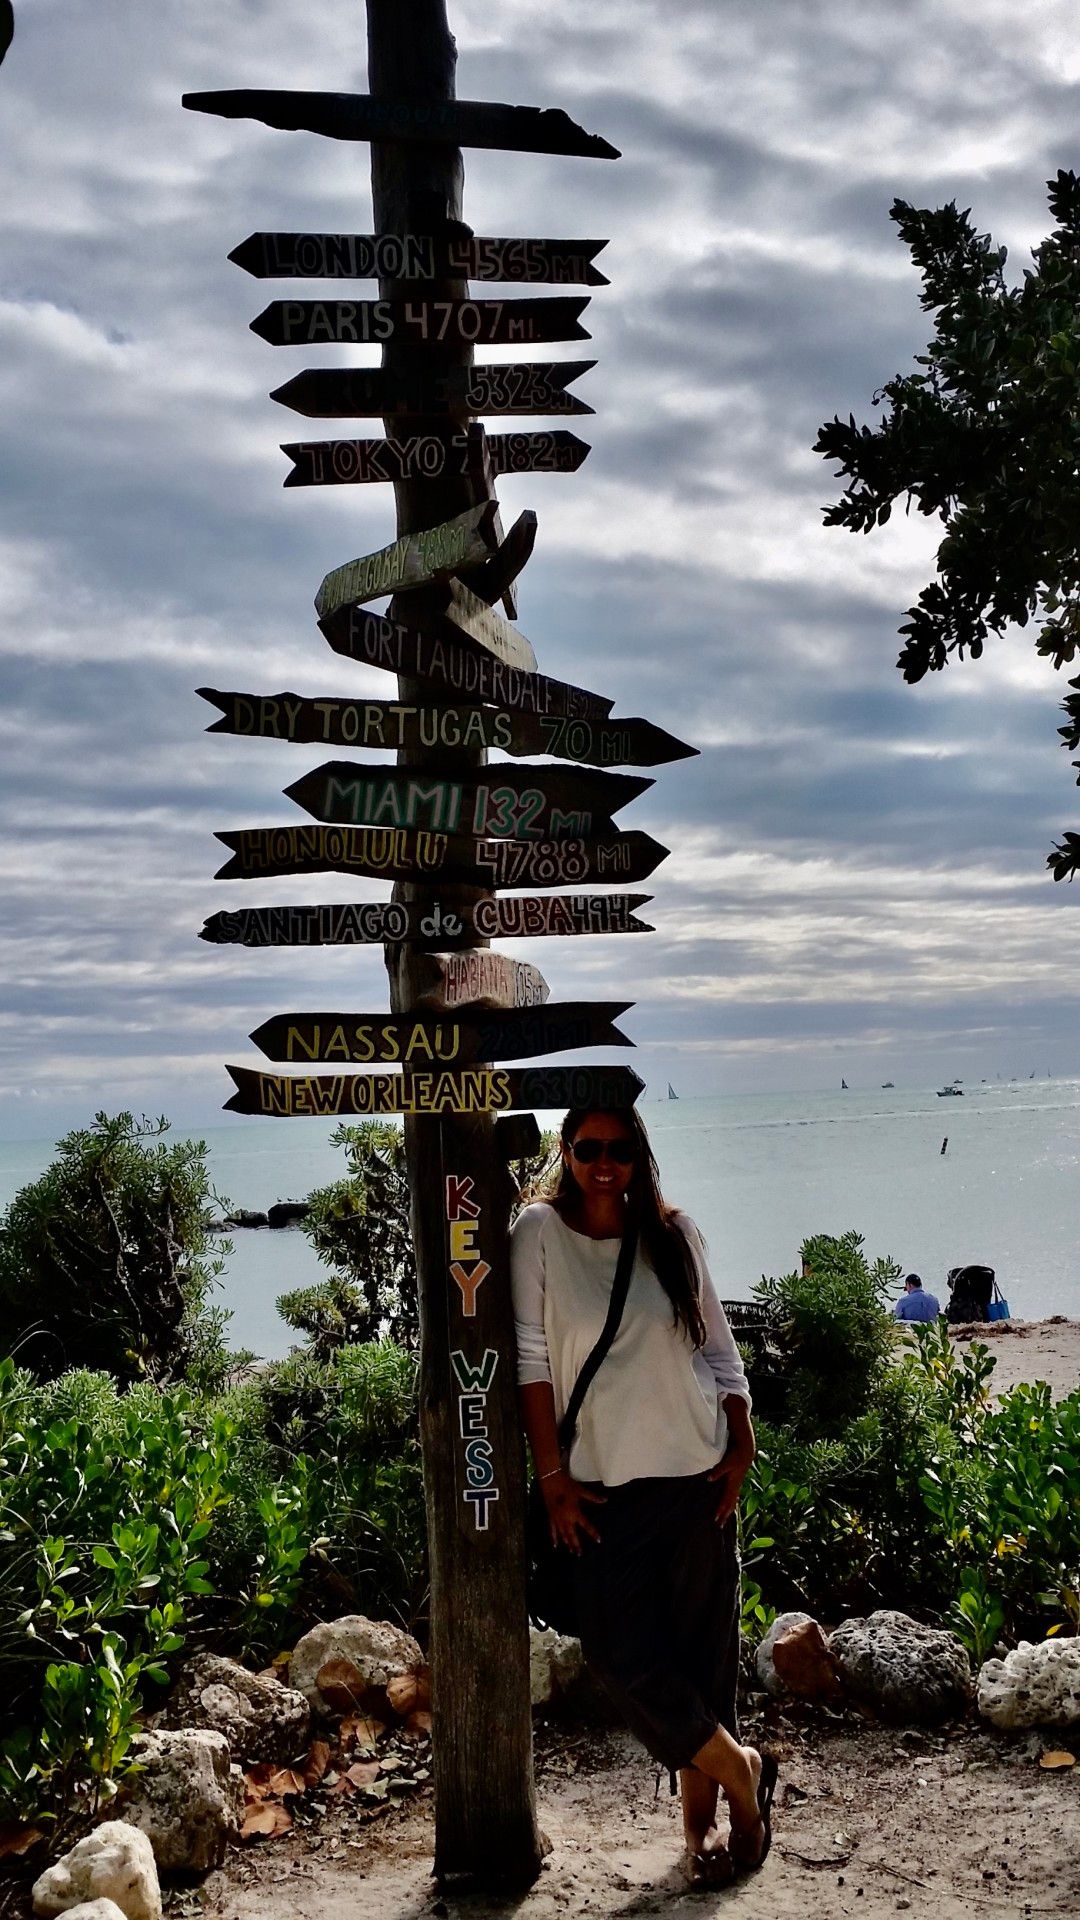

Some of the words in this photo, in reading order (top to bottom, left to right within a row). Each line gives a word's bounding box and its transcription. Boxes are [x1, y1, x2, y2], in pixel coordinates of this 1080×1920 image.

[262, 234, 436, 280] LONDON
[447, 239, 548, 281] 4565
[282, 301, 396, 341] PARIS
[404, 302, 503, 341] 4707
[465, 364, 555, 411] 5323
[300, 435, 446, 483] TOKYO
[349, 610, 409, 668] FORT
[233, 696, 301, 737] DRY
[313, 702, 513, 748] TORTUGAS
[538, 717, 592, 761] 70
[323, 775, 463, 830] MIAMI
[471, 783, 547, 839] 132
[238, 829, 448, 871] HONOLULU
[475, 837, 589, 884] 4788
[596, 843, 632, 873] MI
[218, 903, 409, 944] SANTIAGO
[420, 902, 463, 939] de
[473, 899, 575, 938] CUBA
[286, 1022, 461, 1062] NASSAU
[258, 1074, 346, 1114] NEW
[349, 1069, 515, 1114] ORLEANS
[445, 1175, 492, 1317] KEY
[450, 1349, 499, 1531] WEST
